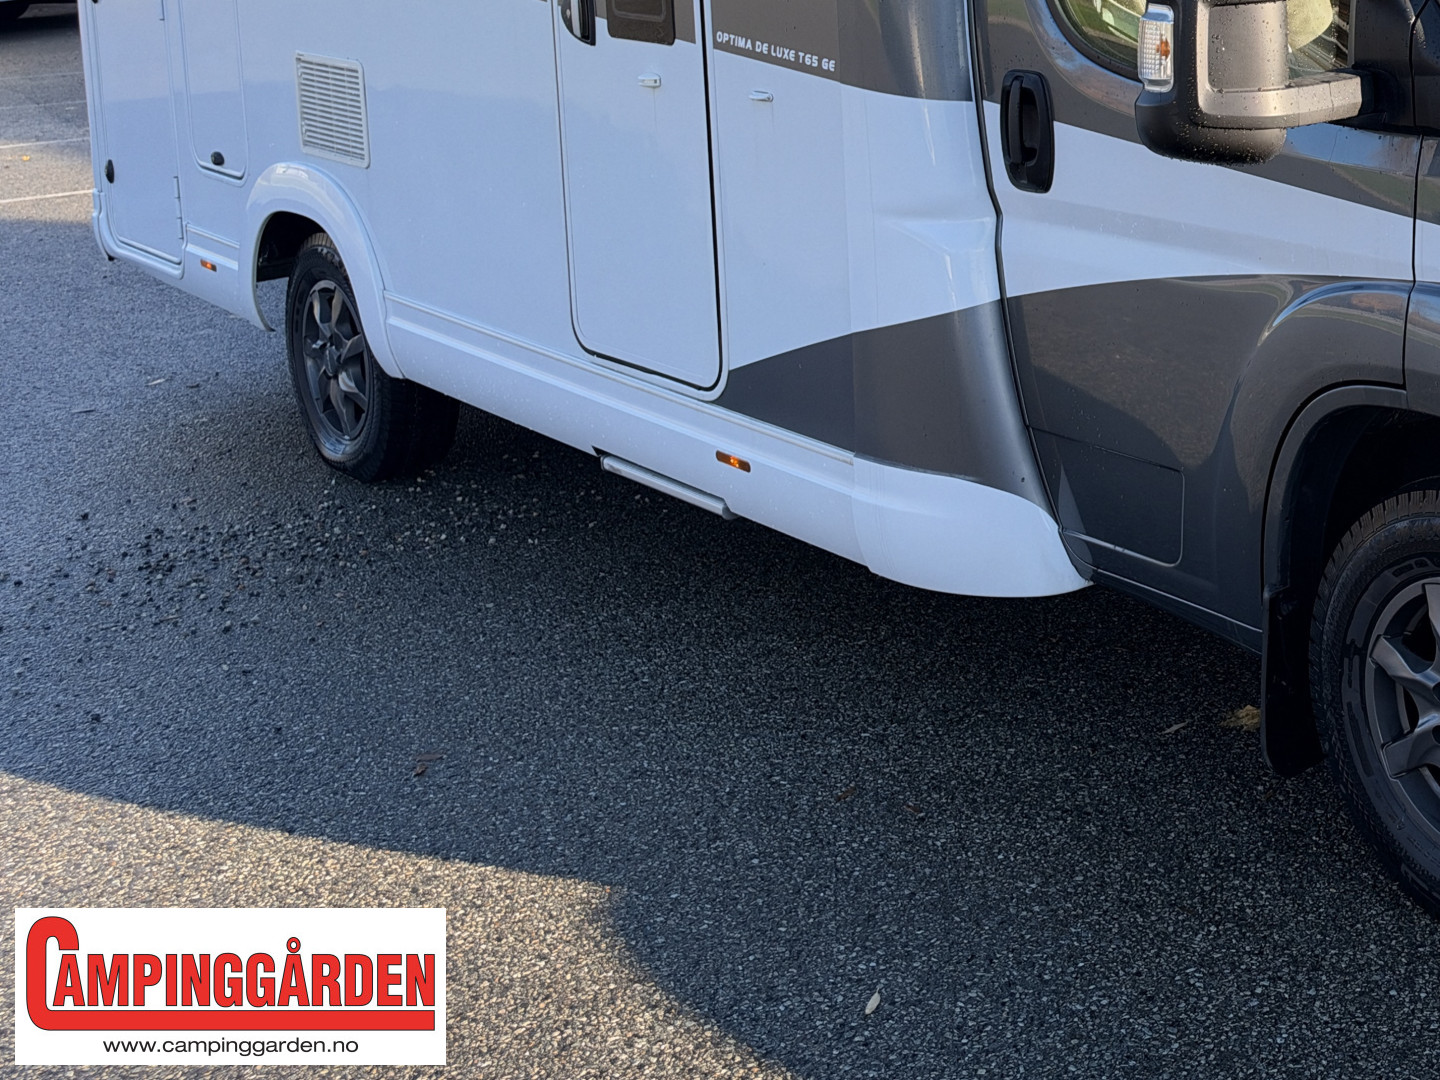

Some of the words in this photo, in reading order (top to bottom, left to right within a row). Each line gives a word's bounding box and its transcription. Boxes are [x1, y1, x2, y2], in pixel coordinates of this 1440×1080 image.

[716, 30, 752, 51] OPTIMA
[755, 41, 769, 55] DE
[771, 44, 796, 62] LUXE
[798, 51, 819, 68] T65
[821, 57, 836, 72] GE
